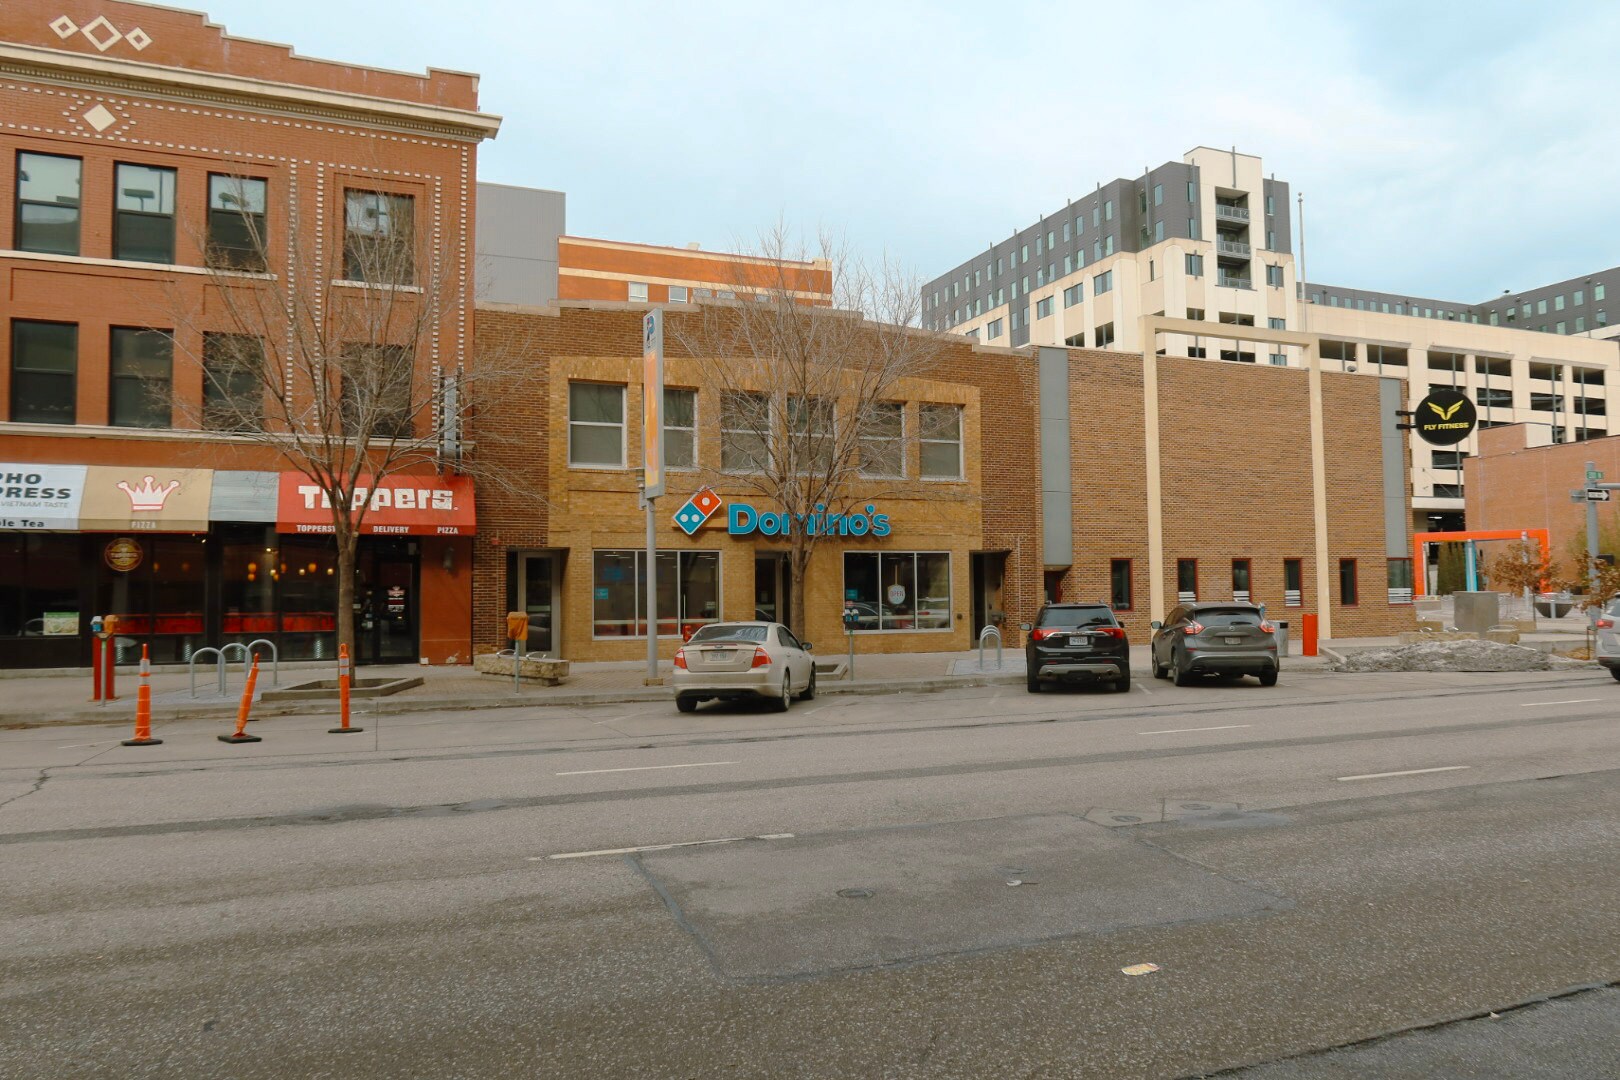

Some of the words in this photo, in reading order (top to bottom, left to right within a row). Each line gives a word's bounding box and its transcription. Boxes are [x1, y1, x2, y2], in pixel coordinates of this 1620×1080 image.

[1438, 422, 1470, 430] FITNESS
[0, 472, 42, 485] HO
[0, 486, 72, 499] RESS
[0, 519, 15, 527] le
[21, 519, 45, 528] Tea
[728, 503, 892, 536] Domino's
[131, 521, 157, 529] PIZZA
[373, 525, 410, 534] DELIVERY
[437, 526, 459, 535] PIZZA
[890, 590, 904, 598] OPEN
